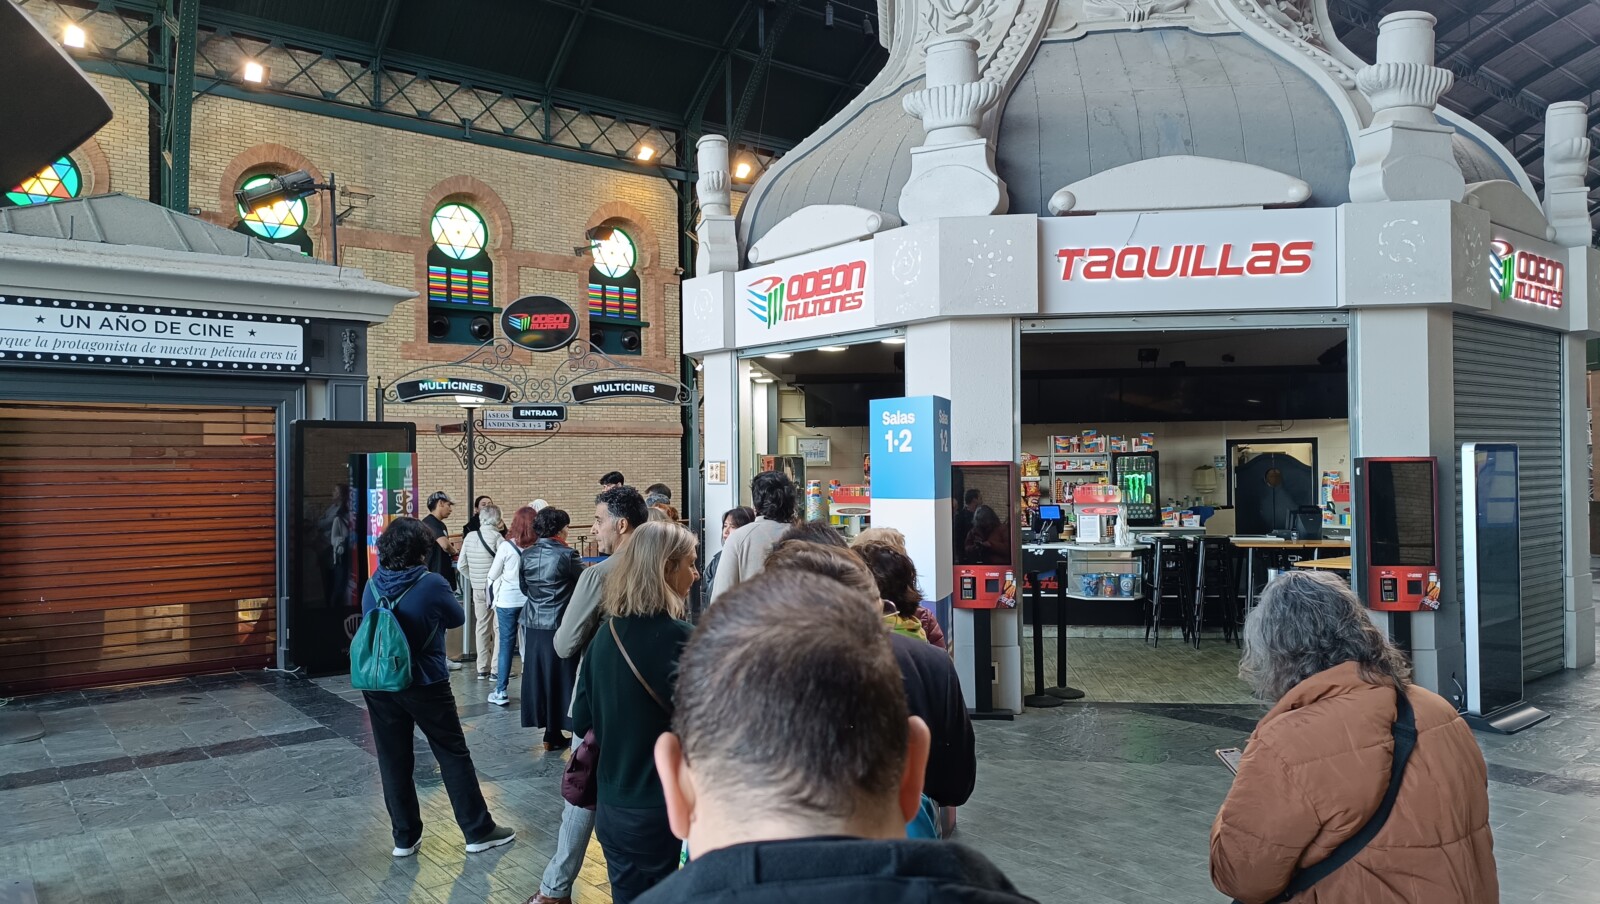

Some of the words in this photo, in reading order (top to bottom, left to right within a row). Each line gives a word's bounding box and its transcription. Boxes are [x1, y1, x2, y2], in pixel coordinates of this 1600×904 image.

[1057, 241, 1314, 281] TAQUILLAS
[1515, 250, 1565, 291] ODEON
[786, 260, 866, 302] ODEON
[59, 314, 91, 330] UN
[98, 314, 147, 334] AÑO
[154, 320, 181, 336] DE
[187, 322, 234, 339] CINE
[530, 313, 571, 324] ODEON
[0, 336, 32, 349] rque
[35, 335, 48, 348] la
[52, 335, 138, 354] protagonista
[141, 341, 157, 354] de
[160, 345, 208, 357] nuestra
[210, 344, 257, 360] película
[260, 348, 283, 361] eres
[285, 348, 298, 362] tú
[418, 380, 484, 393] MULTICINES
[592, 383, 656, 395] MULTICINES
[519, 409, 558, 417] ENTRADA
[882, 410, 915, 426] Salas
[376, 465, 384, 528] Sevilla
[393, 489, 404, 517] ival
